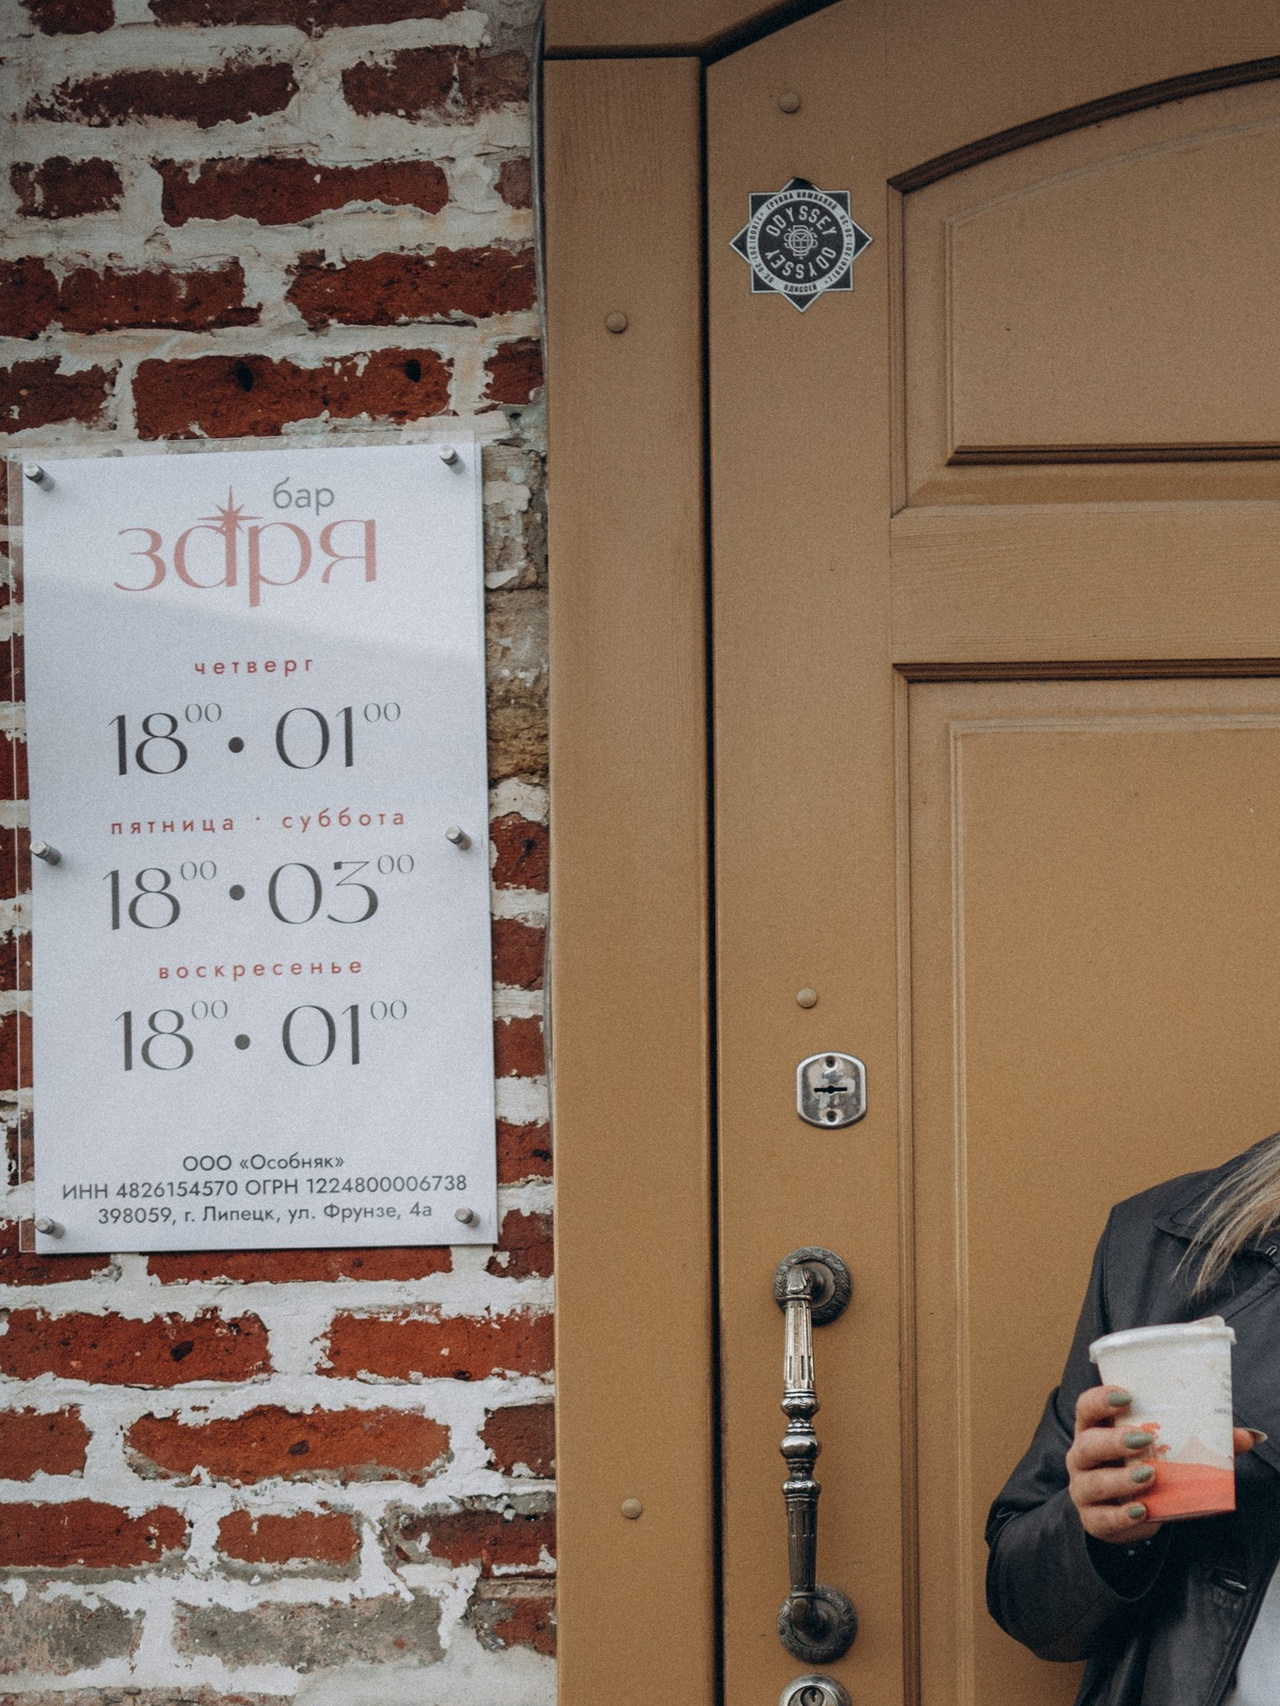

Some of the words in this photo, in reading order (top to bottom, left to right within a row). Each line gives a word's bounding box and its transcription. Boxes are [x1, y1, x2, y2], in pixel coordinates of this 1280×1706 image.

[765, 205, 838, 237] ODYSSEY
[765, 246, 837, 280] ODYSSEY
[272, 477, 335, 516] бар
[112, 518, 378, 608] заря
[194, 658, 314, 678] четверг
[110, 816, 236, 836] пятница
[281, 806, 406, 834] суббота
[158, 959, 364, 982] воскресенье
[182, 1155, 233, 1173] ООО
[239, 1151, 346, 1171] «Особняк»
[62, 1183, 109, 1200] ИНН
[115, 1178, 239, 1199] 4826154570
[244, 1178, 299, 1198] ОГРН
[305, 1174, 468, 1195] 1224800006738
[98, 1206, 178, 1226] 398059,
[184, 1210, 196, 1223] г.
[202, 1205, 281, 1225] Липецк,
[286, 1208, 316, 1225] ул.
[322, 1203, 402, 1224] Фрунзе,
[408, 1201, 434, 1217] 4а
